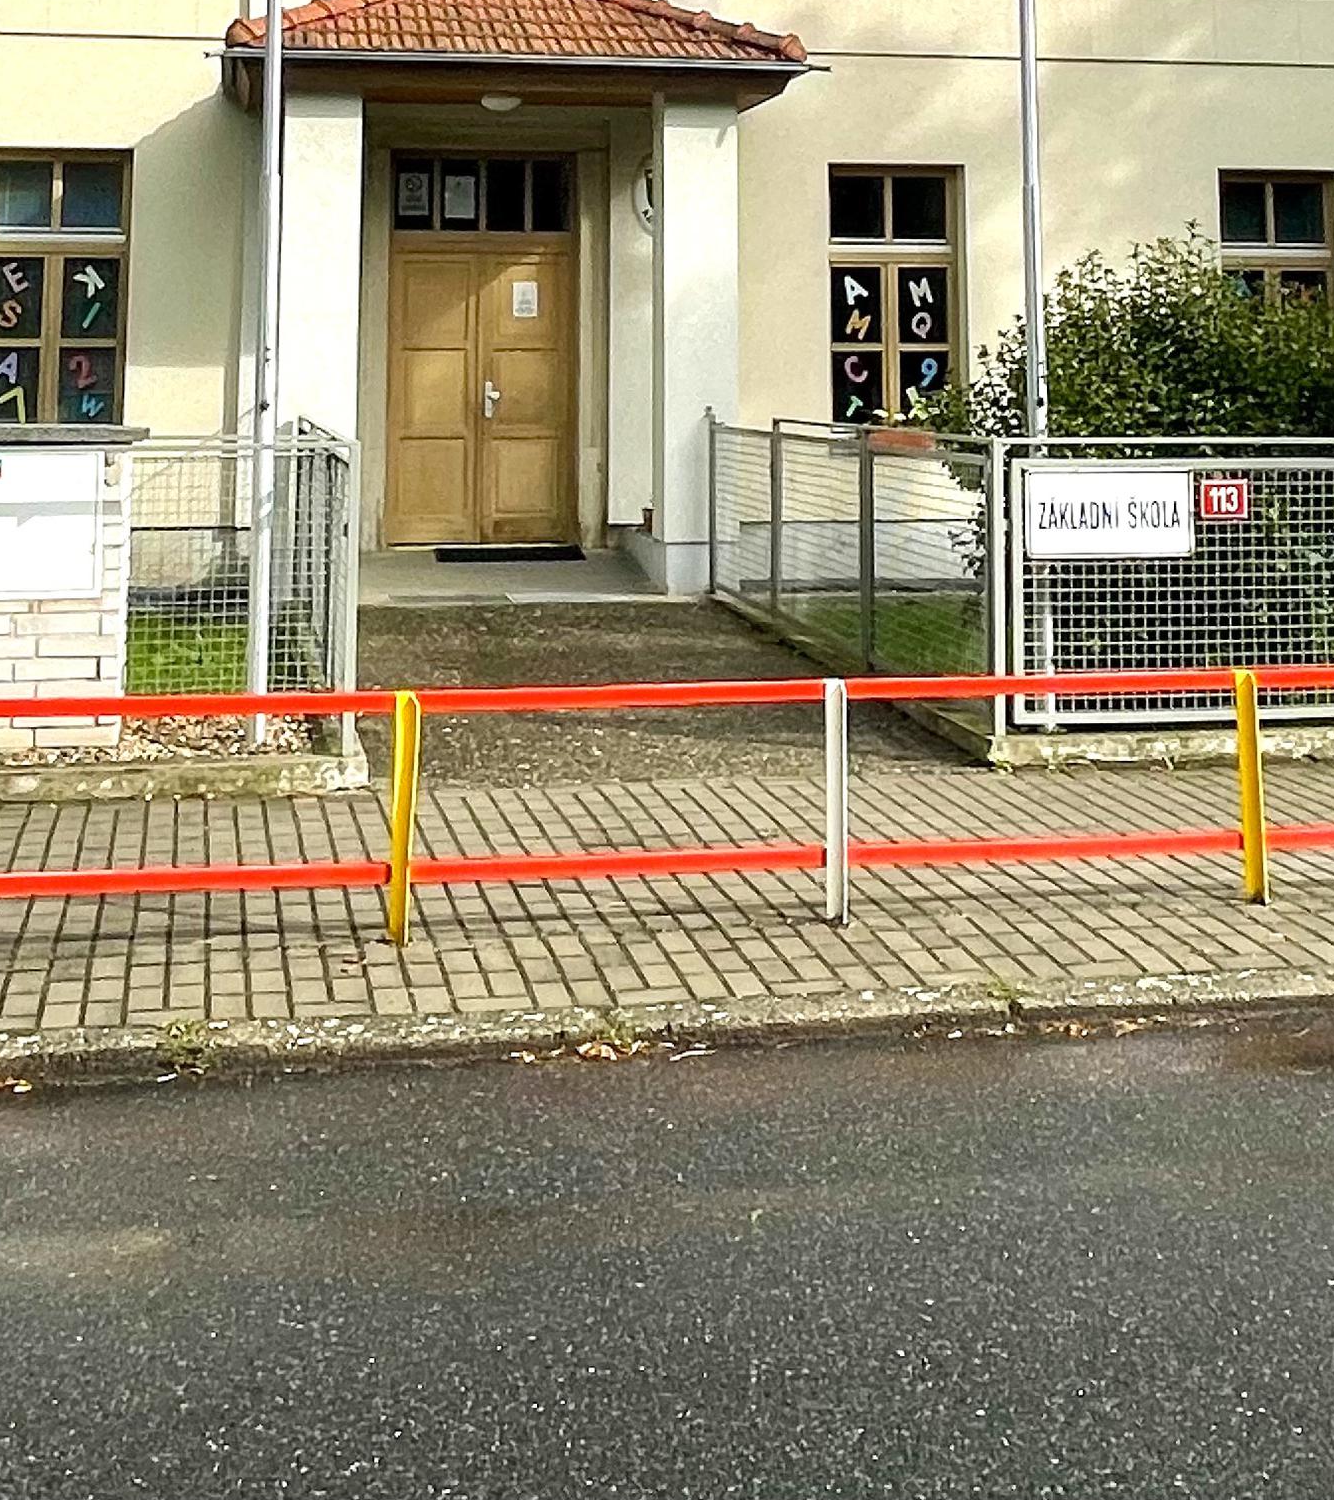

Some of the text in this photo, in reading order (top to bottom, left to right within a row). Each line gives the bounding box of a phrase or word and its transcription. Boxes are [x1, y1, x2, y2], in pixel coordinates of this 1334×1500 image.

[3, 262, 30, 293] E
[844, 275, 869, 305] A
[908, 277, 934, 307] M
[845, 309, 872, 340] M
[912, 311, 932, 339] Q
[844, 356, 868, 383] C
[921, 358, 938, 387] 9
[846, 395, 863, 417] T
[1038, 497, 1181, 529] ZÁKLADNÍ ŠKOLA
[1208, 486, 1239, 513] 113
